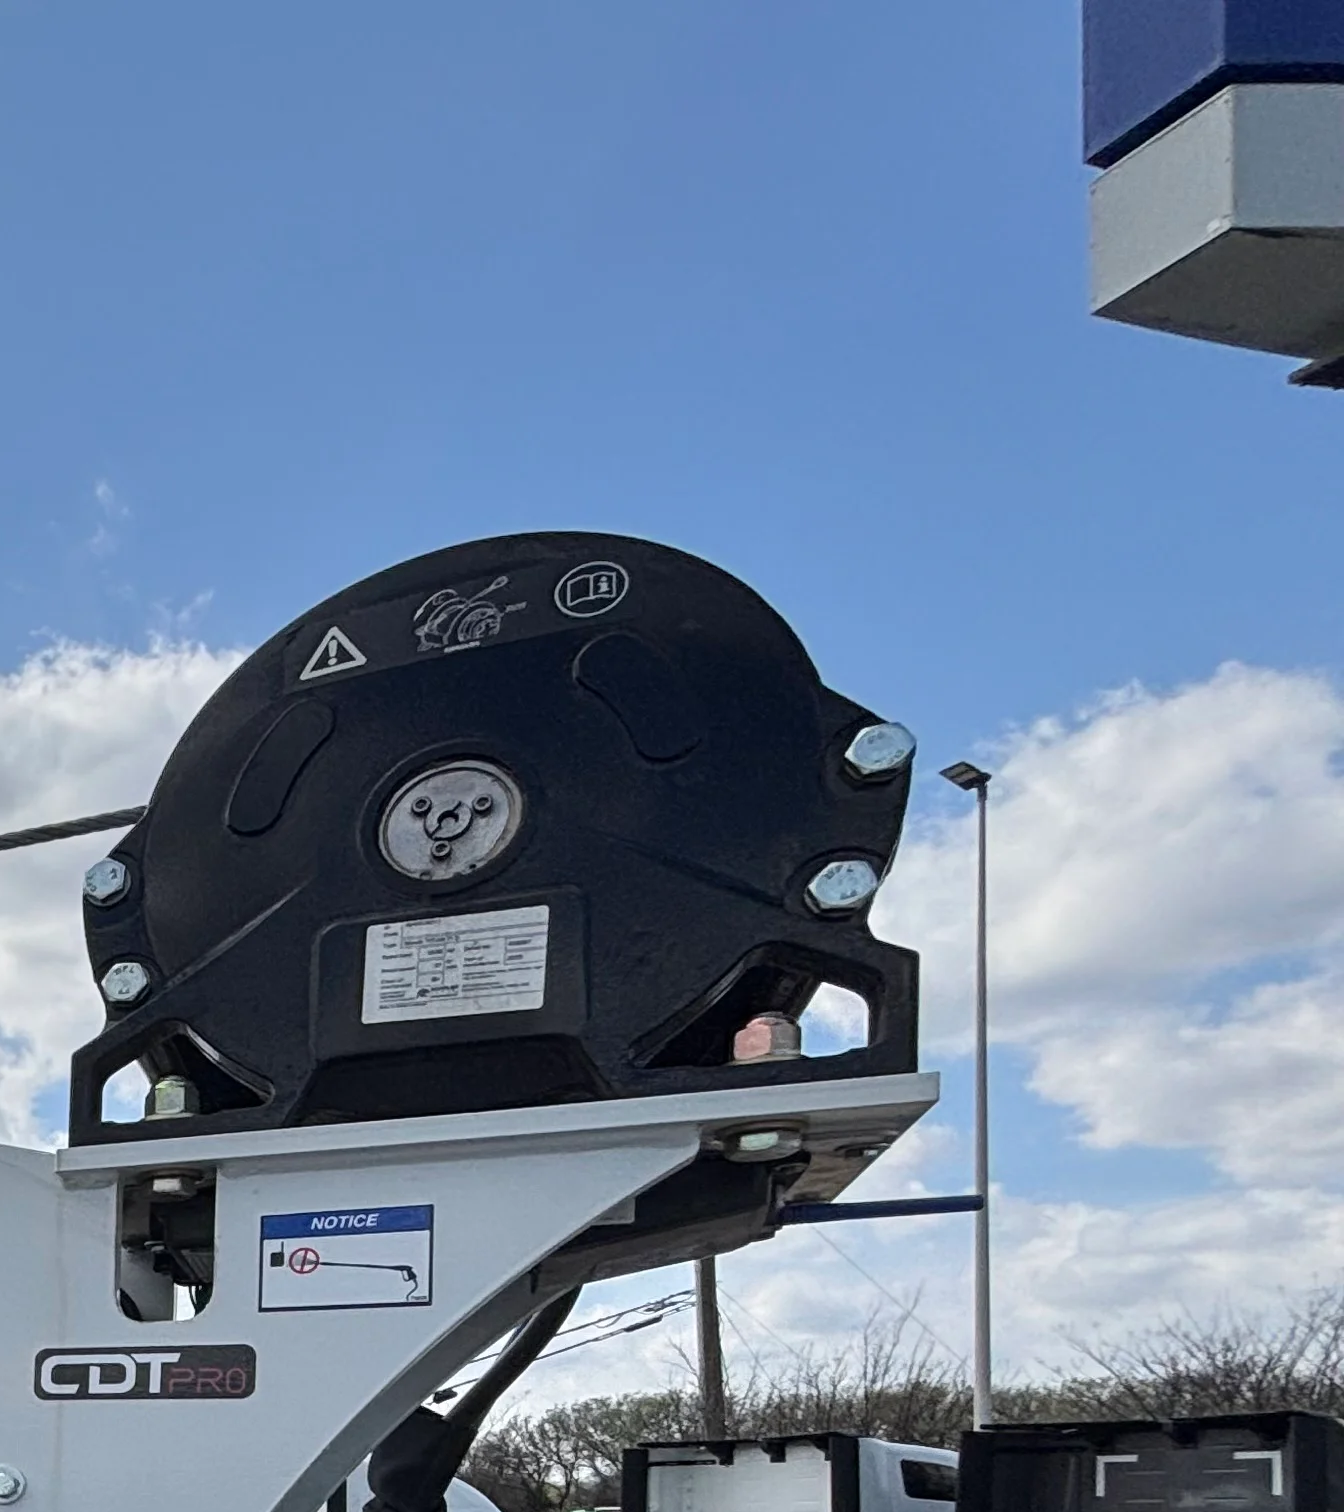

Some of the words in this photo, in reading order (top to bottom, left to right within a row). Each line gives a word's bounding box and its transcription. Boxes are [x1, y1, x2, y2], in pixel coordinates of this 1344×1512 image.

[310, 1213, 380, 1230] NOTICE
[40, 1352, 181, 1394] CDT
[168, 1367, 246, 1394] PRO
